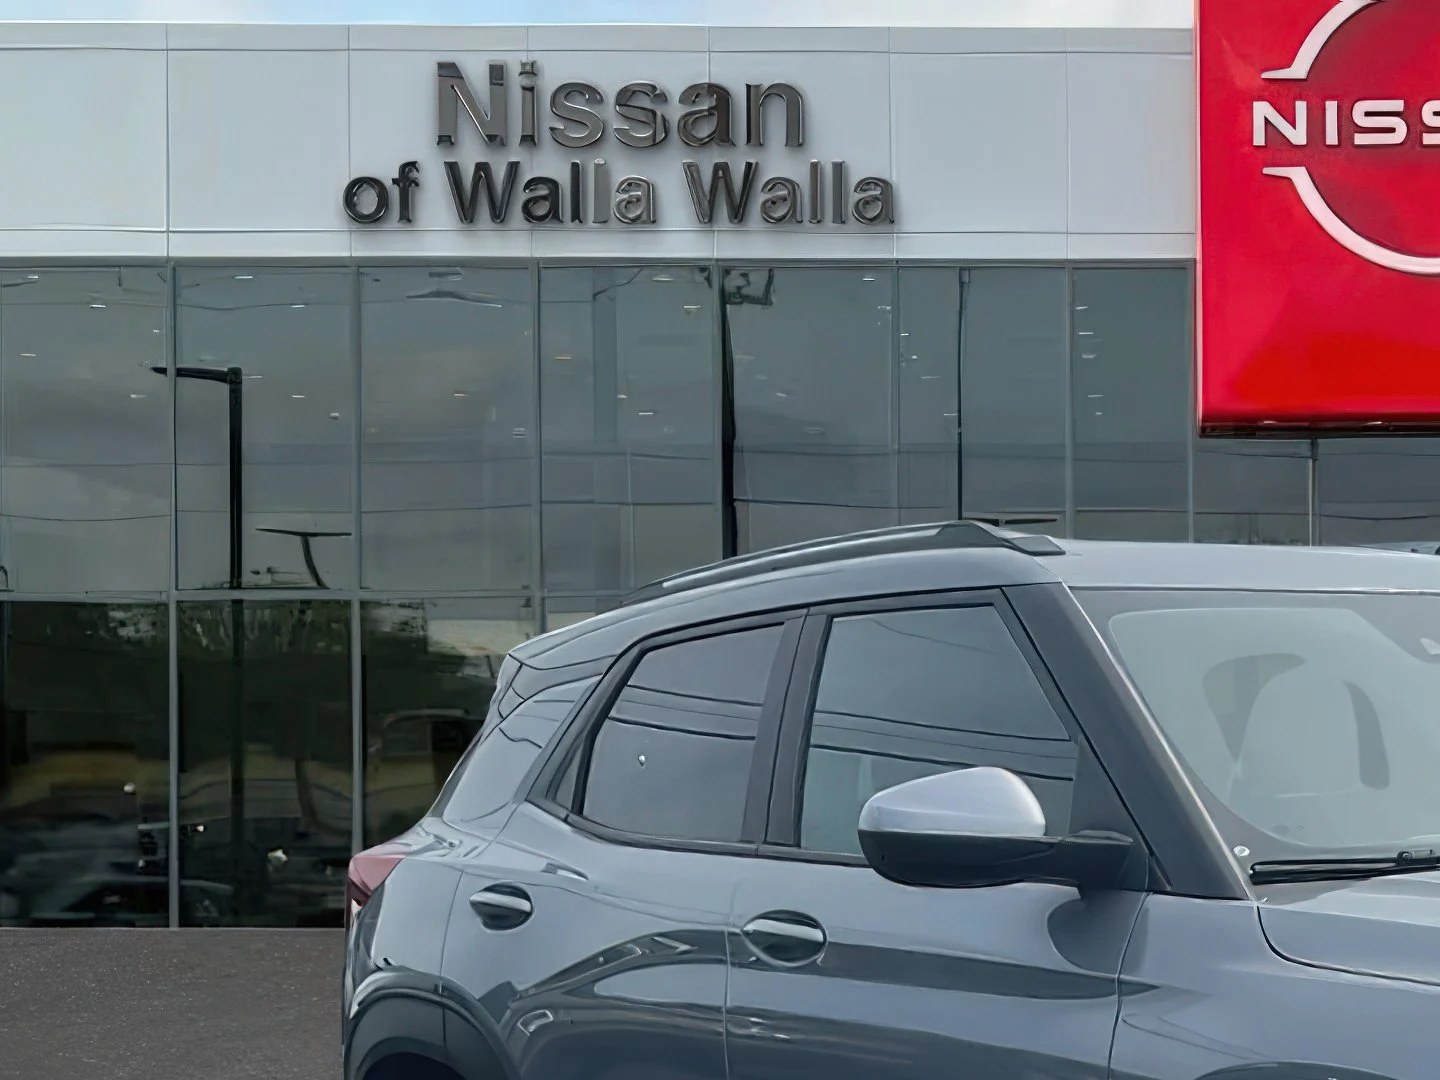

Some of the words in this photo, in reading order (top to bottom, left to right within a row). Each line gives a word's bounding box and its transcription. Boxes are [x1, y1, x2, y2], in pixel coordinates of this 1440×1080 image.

[436, 60, 804, 147] Nissan
[342, 161, 421, 224] of
[444, 160, 656, 224] Walla
[682, 160, 895, 224] Walla
